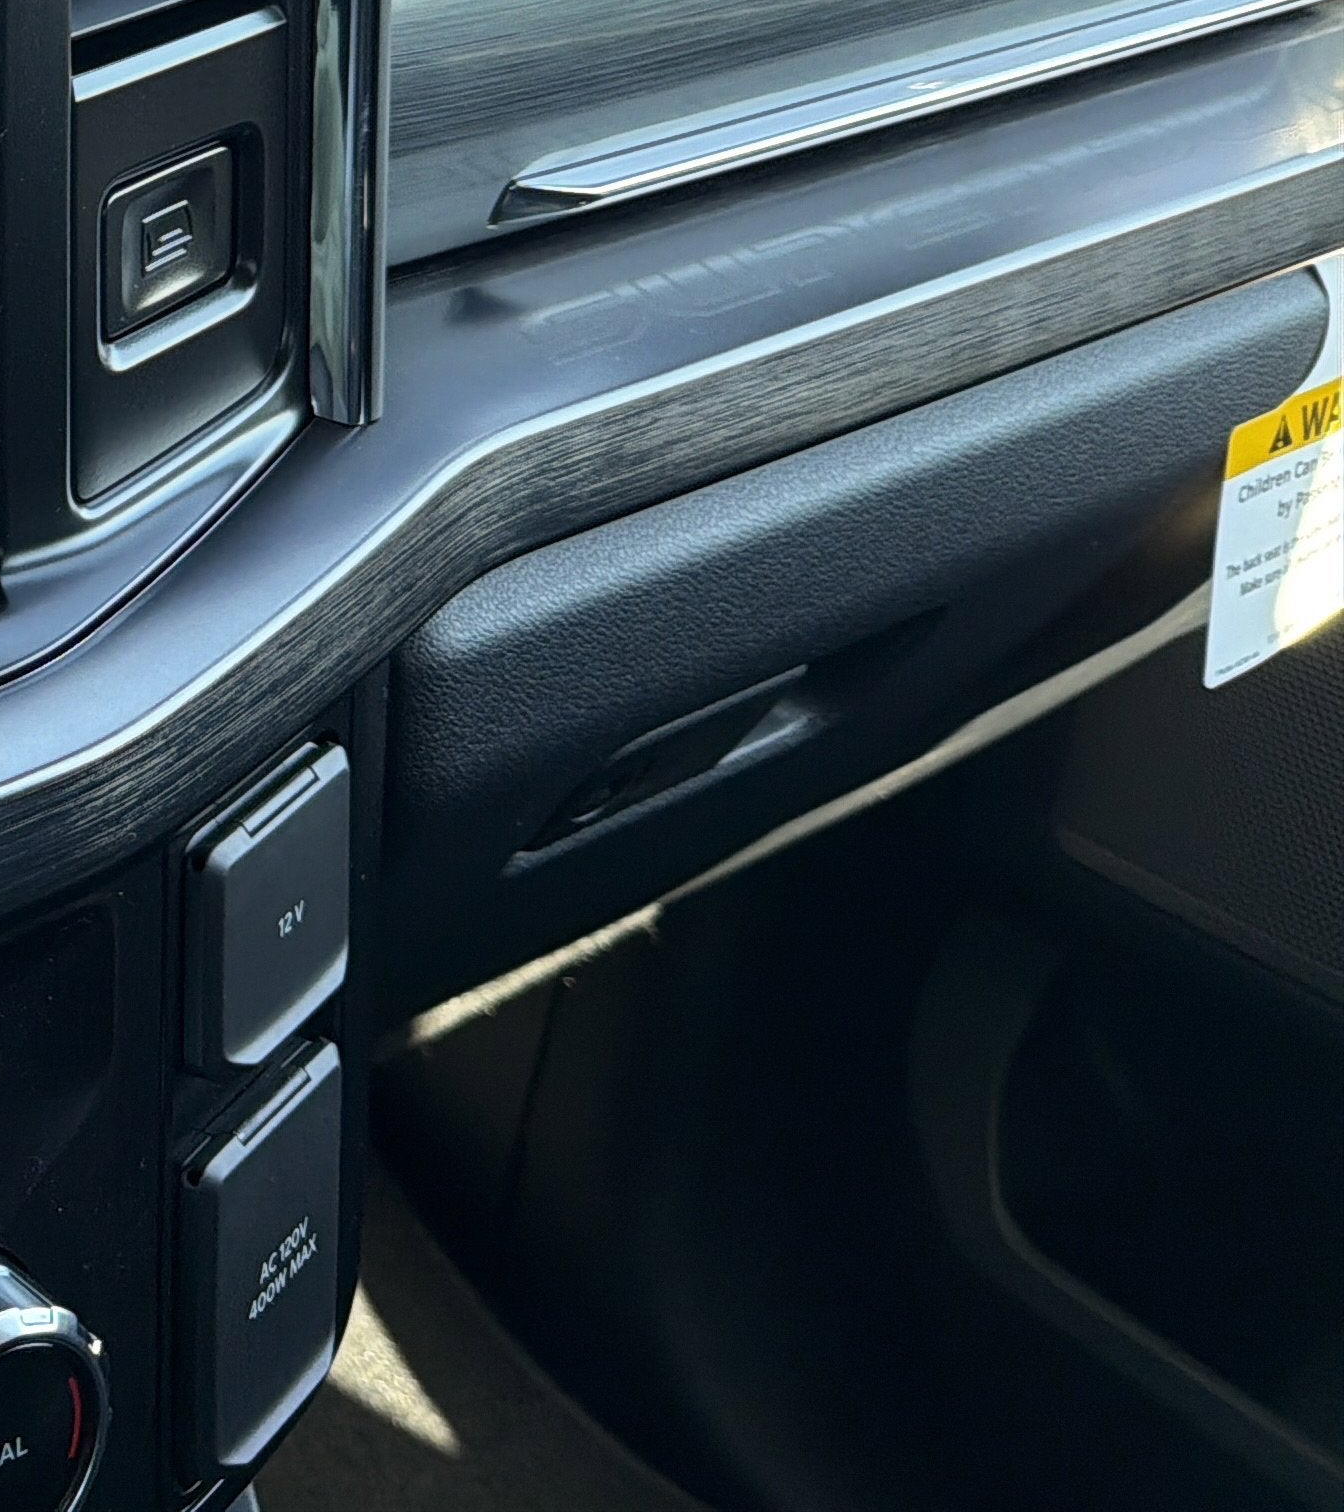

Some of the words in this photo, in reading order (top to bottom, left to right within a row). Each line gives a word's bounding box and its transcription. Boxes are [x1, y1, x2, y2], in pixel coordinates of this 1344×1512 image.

[1238, 472, 1292, 504] Children
[1294, 458, 1319, 479] Can
[278, 910, 293, 938] 12
[294, 899, 305, 923] V
[248, 1267, 288, 1320] 400W
[289, 1232, 318, 1279] MAX
[259, 1251, 278, 1285] AC
[279, 1215, 309, 1262] 120V
